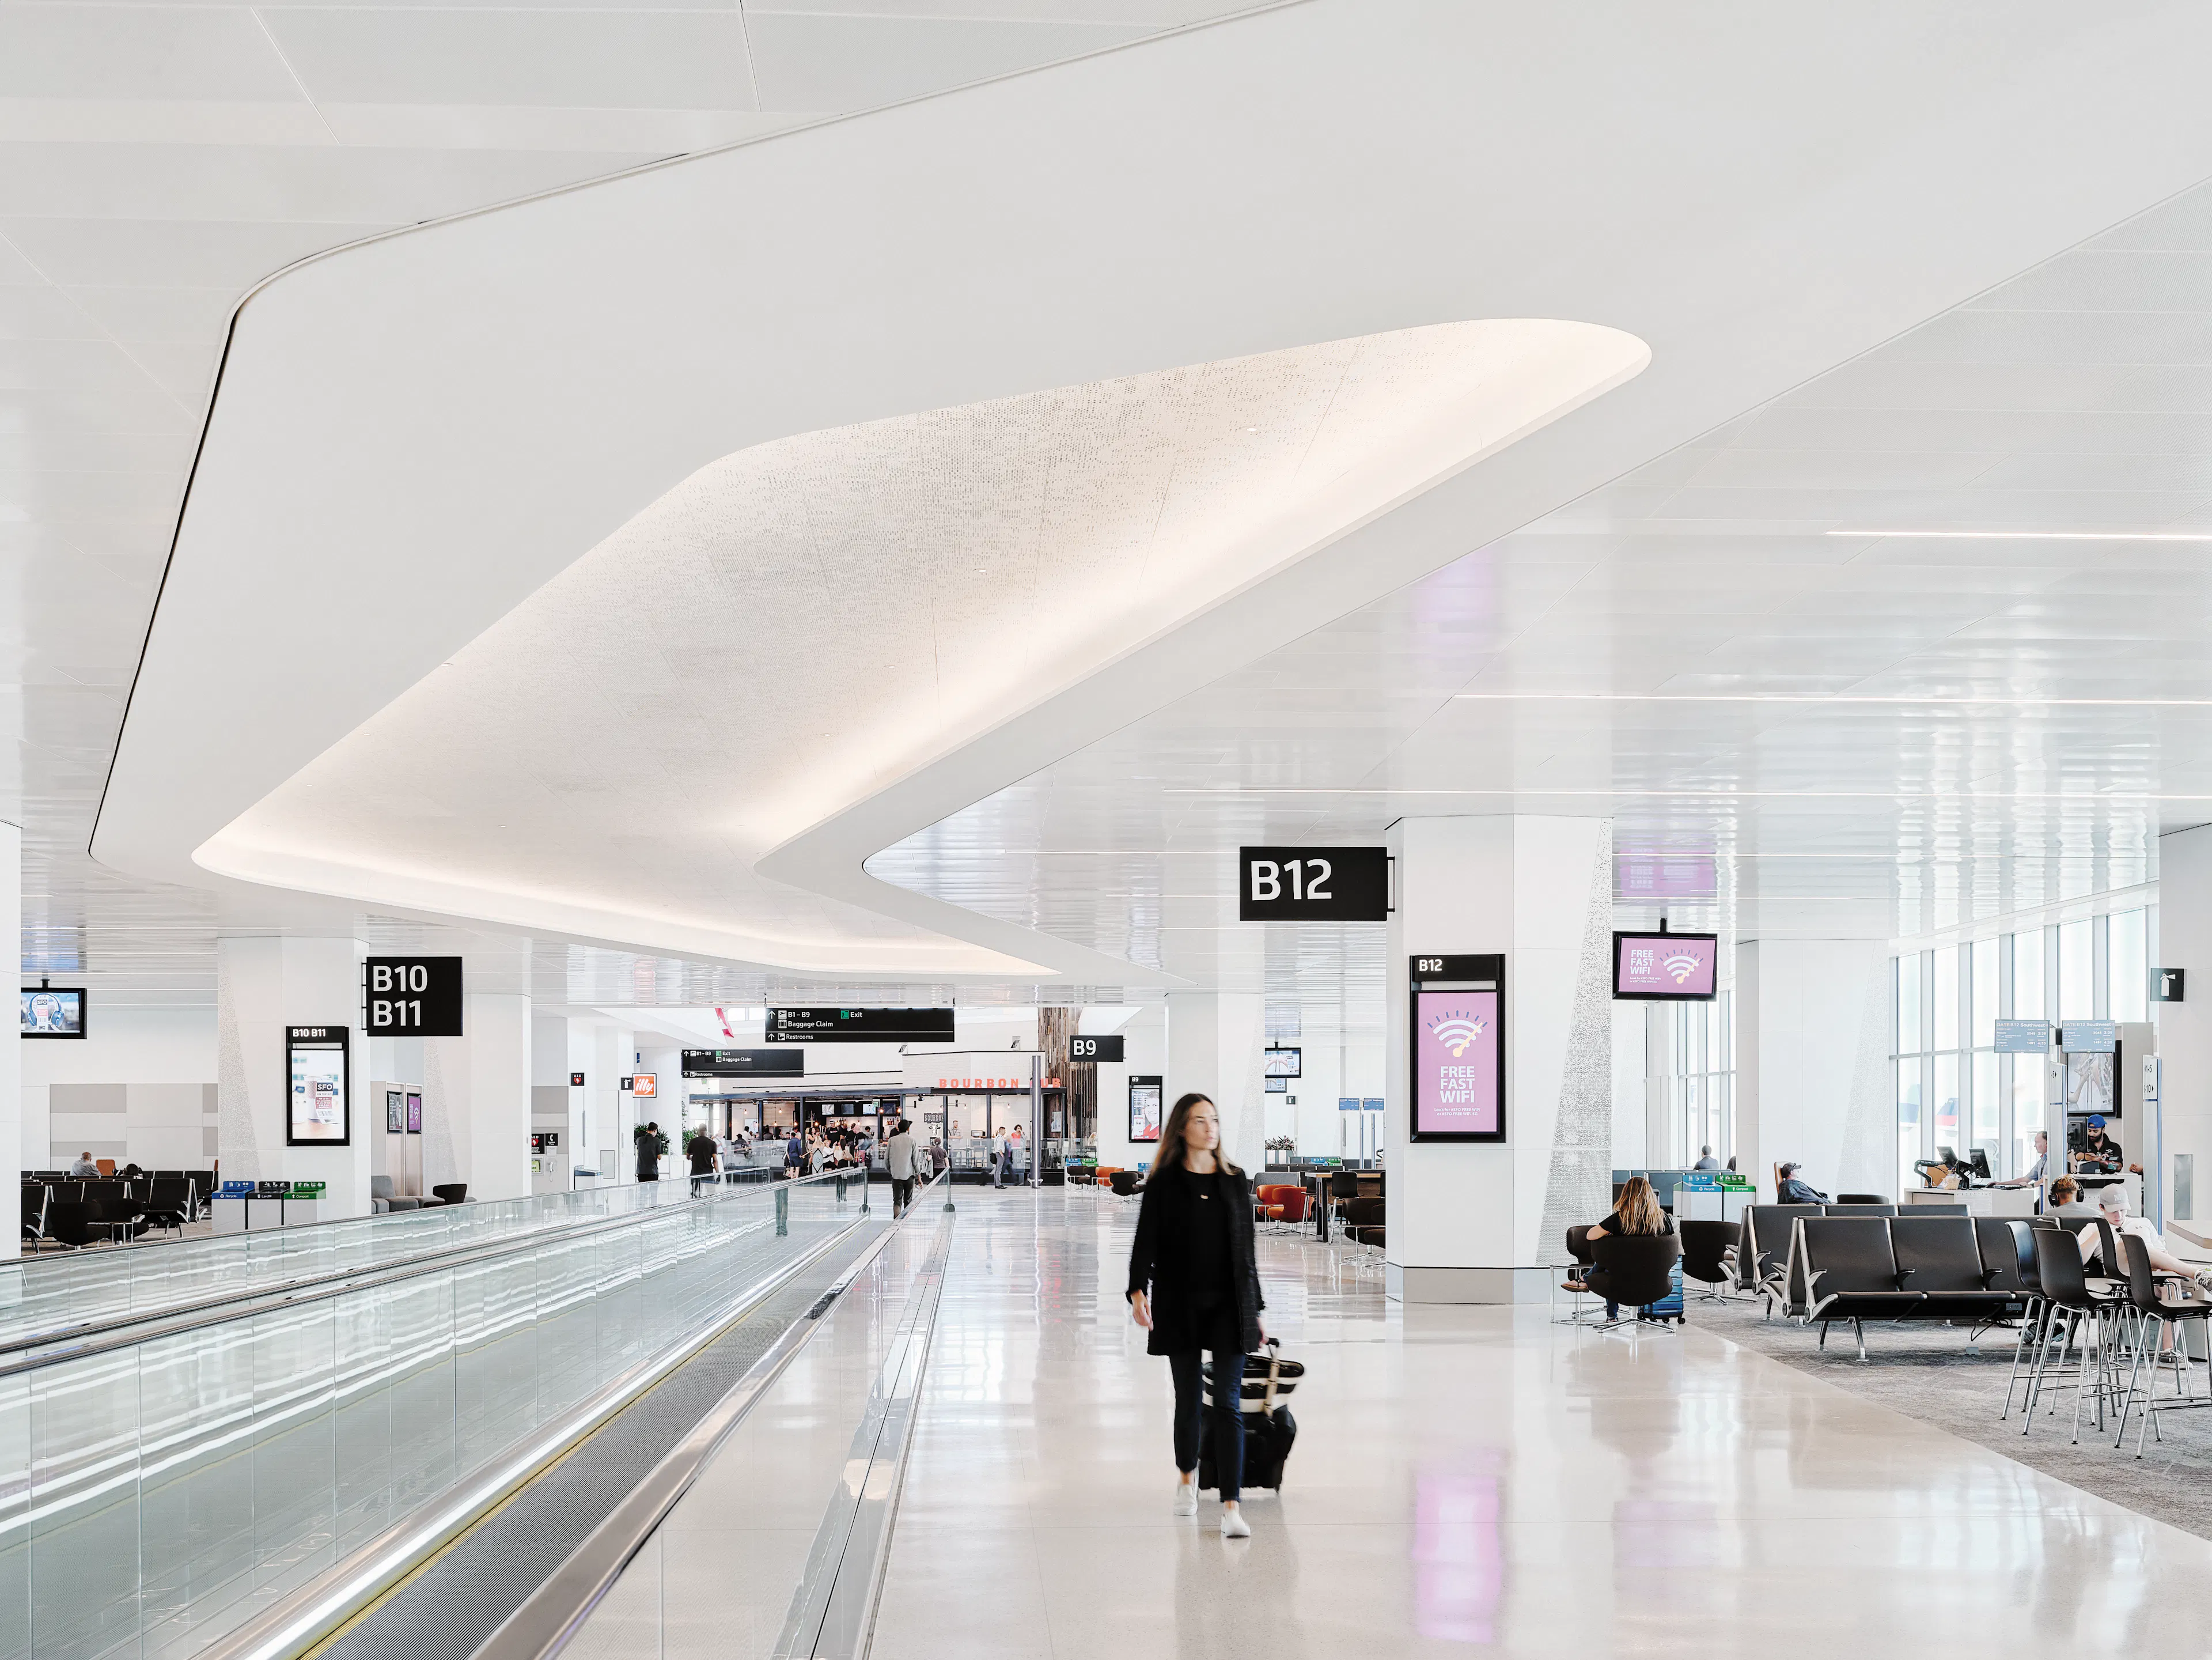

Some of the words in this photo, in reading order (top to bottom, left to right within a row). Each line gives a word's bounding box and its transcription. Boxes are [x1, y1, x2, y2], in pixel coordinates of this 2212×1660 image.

[1251, 859, 1332, 901] B12
[1631, 950, 1654, 958] FREE
[1419, 959, 1442, 971] B12
[1630, 958, 1654, 966] FAST
[1630, 966, 1650, 974] WIFI
[373, 965, 428, 992] B10
[373, 1000, 421, 1026] B11
[292, 1028, 309, 1037] B10
[311, 1028, 326, 1037] B11
[1073, 1039, 1096, 1055] B9
[1440, 1066, 1475, 1077] FREE
[635, 1078, 654, 1094] illy
[939, 1078, 1019, 1088] BOURBON
[1030, 1078, 1060, 1088] UB
[1440, 1078, 1475, 1089] FAST
[1440, 1090, 1475, 1103] WIFI
